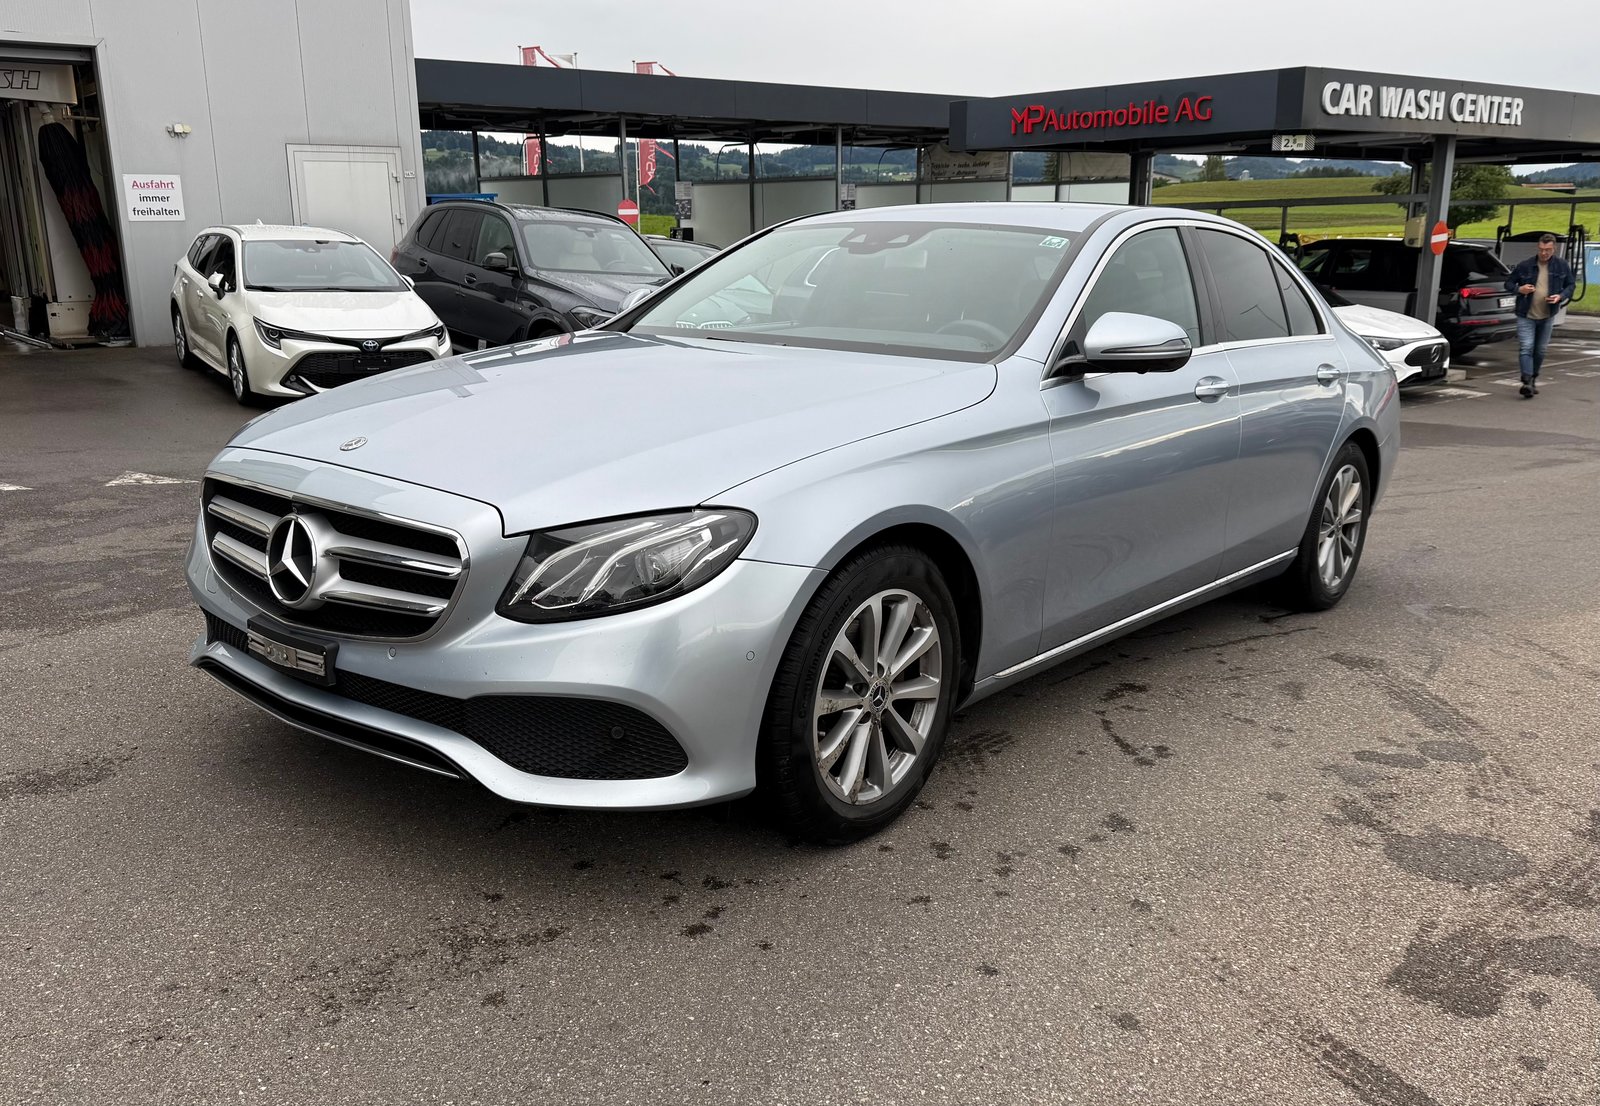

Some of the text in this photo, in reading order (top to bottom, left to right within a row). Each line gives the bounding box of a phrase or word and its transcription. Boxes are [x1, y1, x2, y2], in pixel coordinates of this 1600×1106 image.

[1322, 81, 1526, 126] CAR WASH CENTER
[1011, 96, 1212, 135] MPAutomobile AG
[132, 180, 175, 190] Ausfahrt
[139, 194, 170, 202] immer
[132, 207, 180, 216] freihalten
